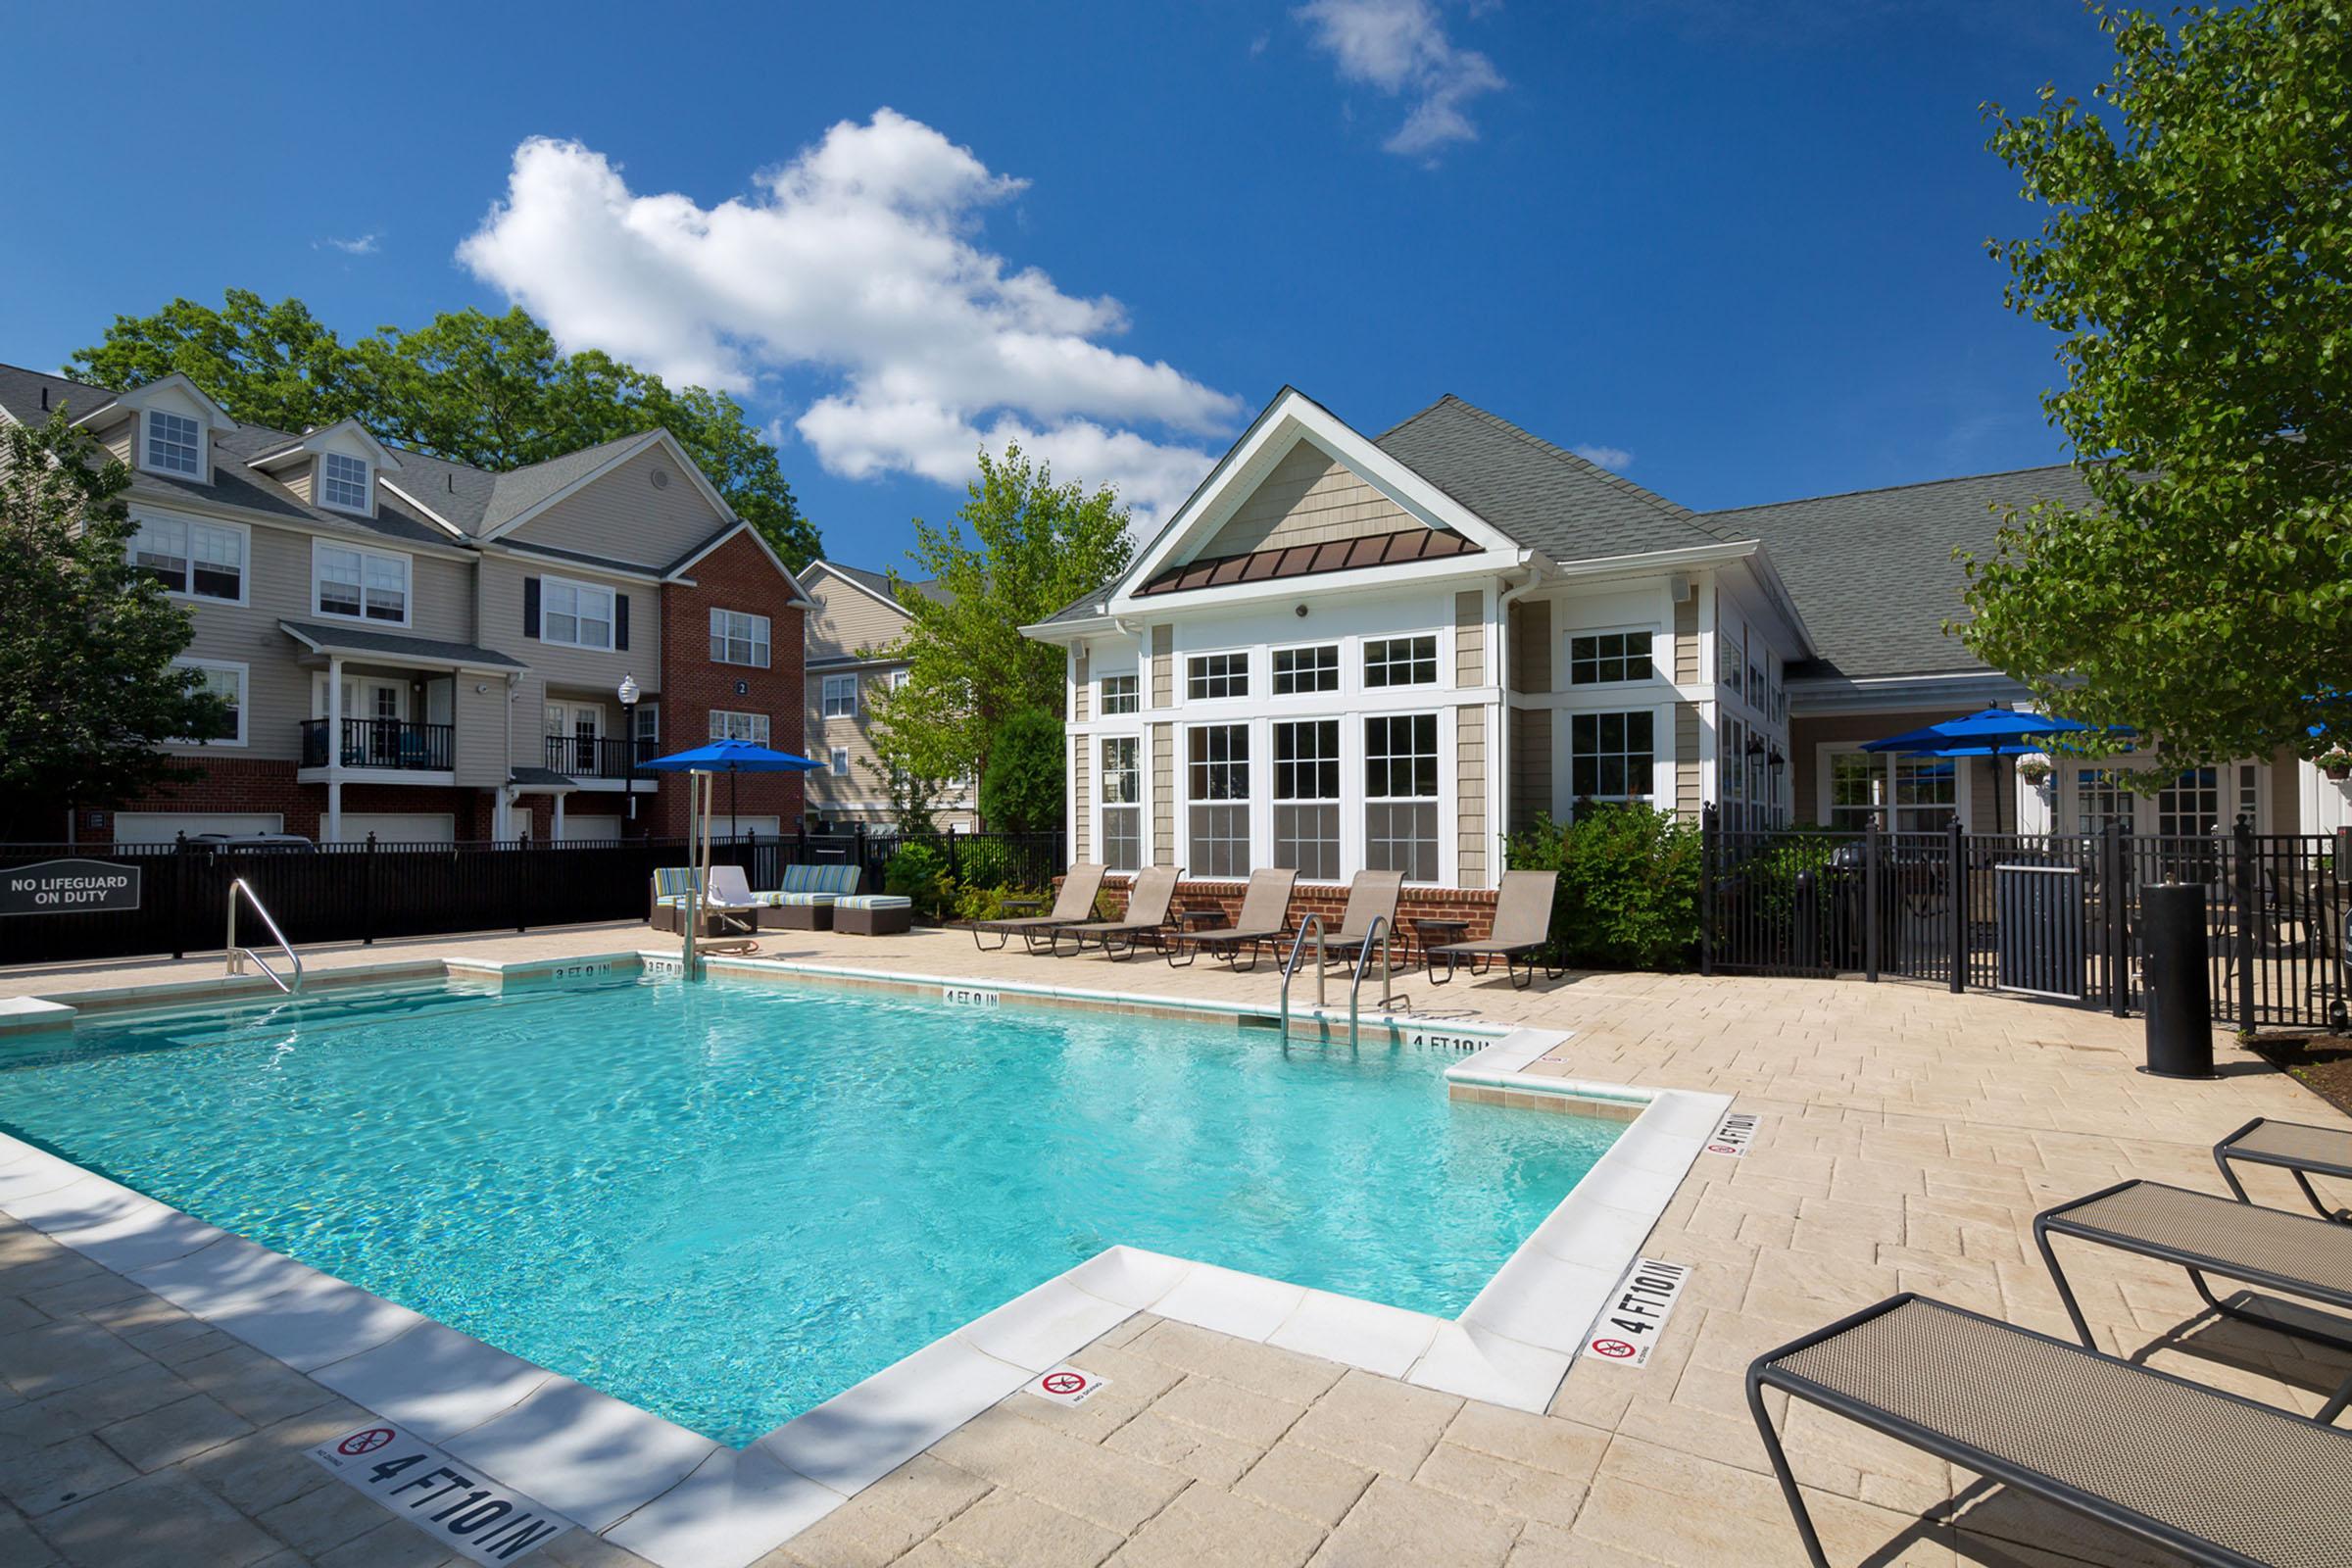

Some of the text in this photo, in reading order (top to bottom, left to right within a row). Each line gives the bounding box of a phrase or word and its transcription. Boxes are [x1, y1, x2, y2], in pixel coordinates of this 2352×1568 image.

[739, 683, 746, 694] 2
[11, 876, 128, 892] NO LIFEGUARD
[34, 890, 108, 905] ON DUTY
[1610, 1317, 1654, 1335] 4
[368, 1453, 428, 1484] 4
